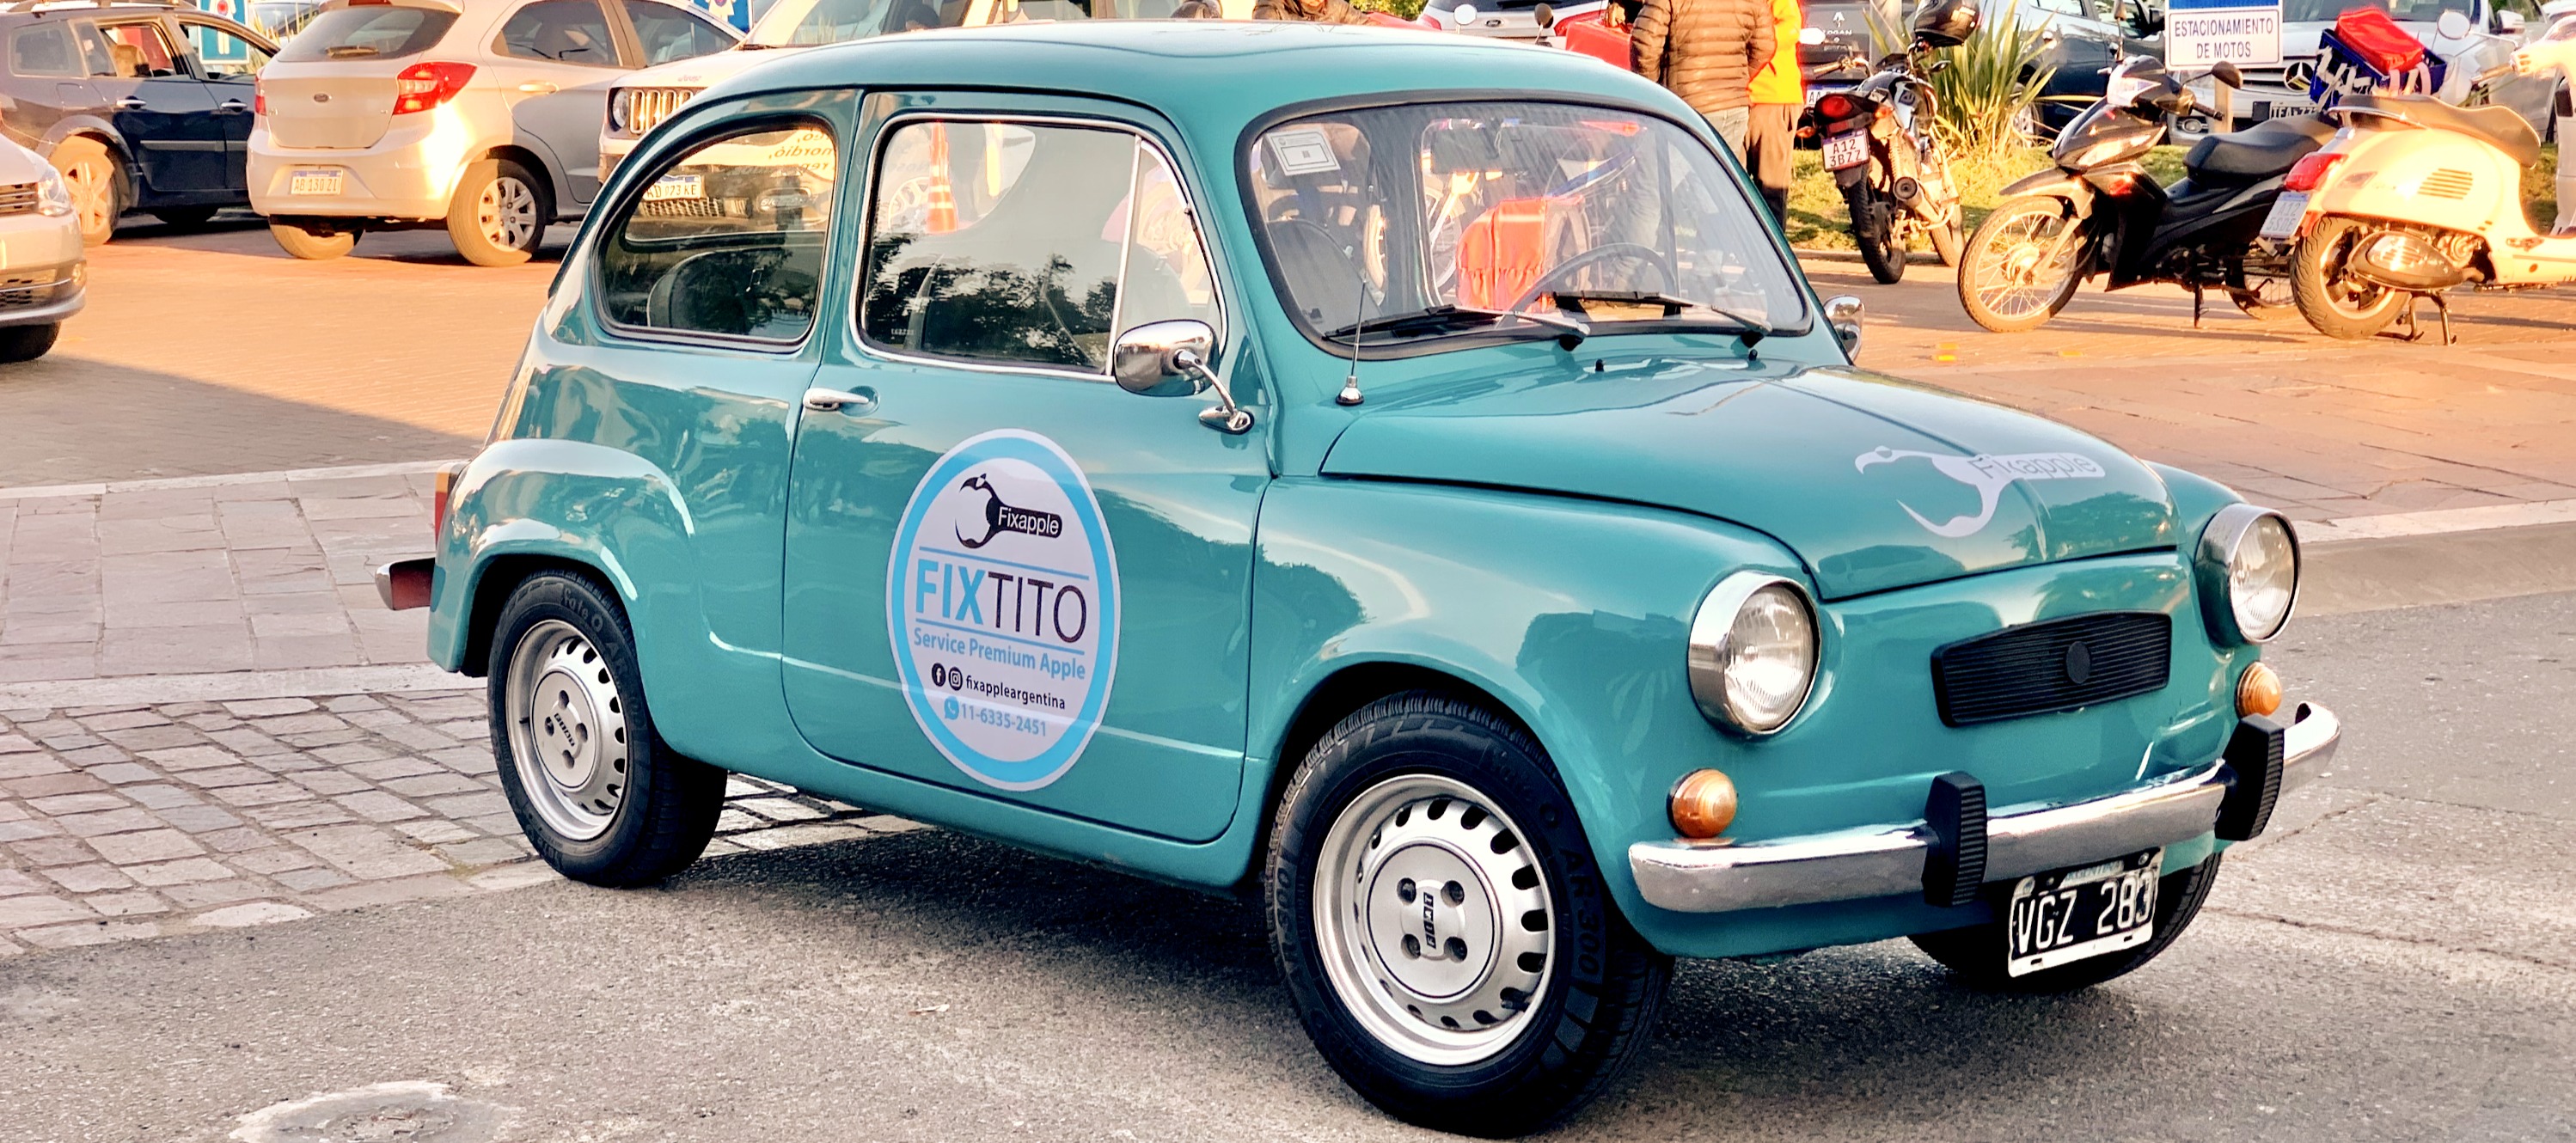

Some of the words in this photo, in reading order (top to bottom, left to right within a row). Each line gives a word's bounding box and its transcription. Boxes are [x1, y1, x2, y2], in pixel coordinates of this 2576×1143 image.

[2175, 17, 2273, 37] ESTACIONAMIENTO
[2197, 43, 2210, 58] DE
[2214, 41, 2251, 58] MOTOS
[1833, 139, 1856, 154] A12
[998, 506, 1060, 536] Fixapple
[915, 558, 1087, 644] FIXTITO
[914, 627, 965, 655] Service
[969, 638, 1036, 669] Premium
[1039, 652, 1086, 681] Apple
[965, 675, 1066, 710] fixappleargentina
[960, 703, 1047, 737] 11-6335-2451
[2018, 889, 2077, 954] VGZ
[2097, 871, 2155, 936] 283
